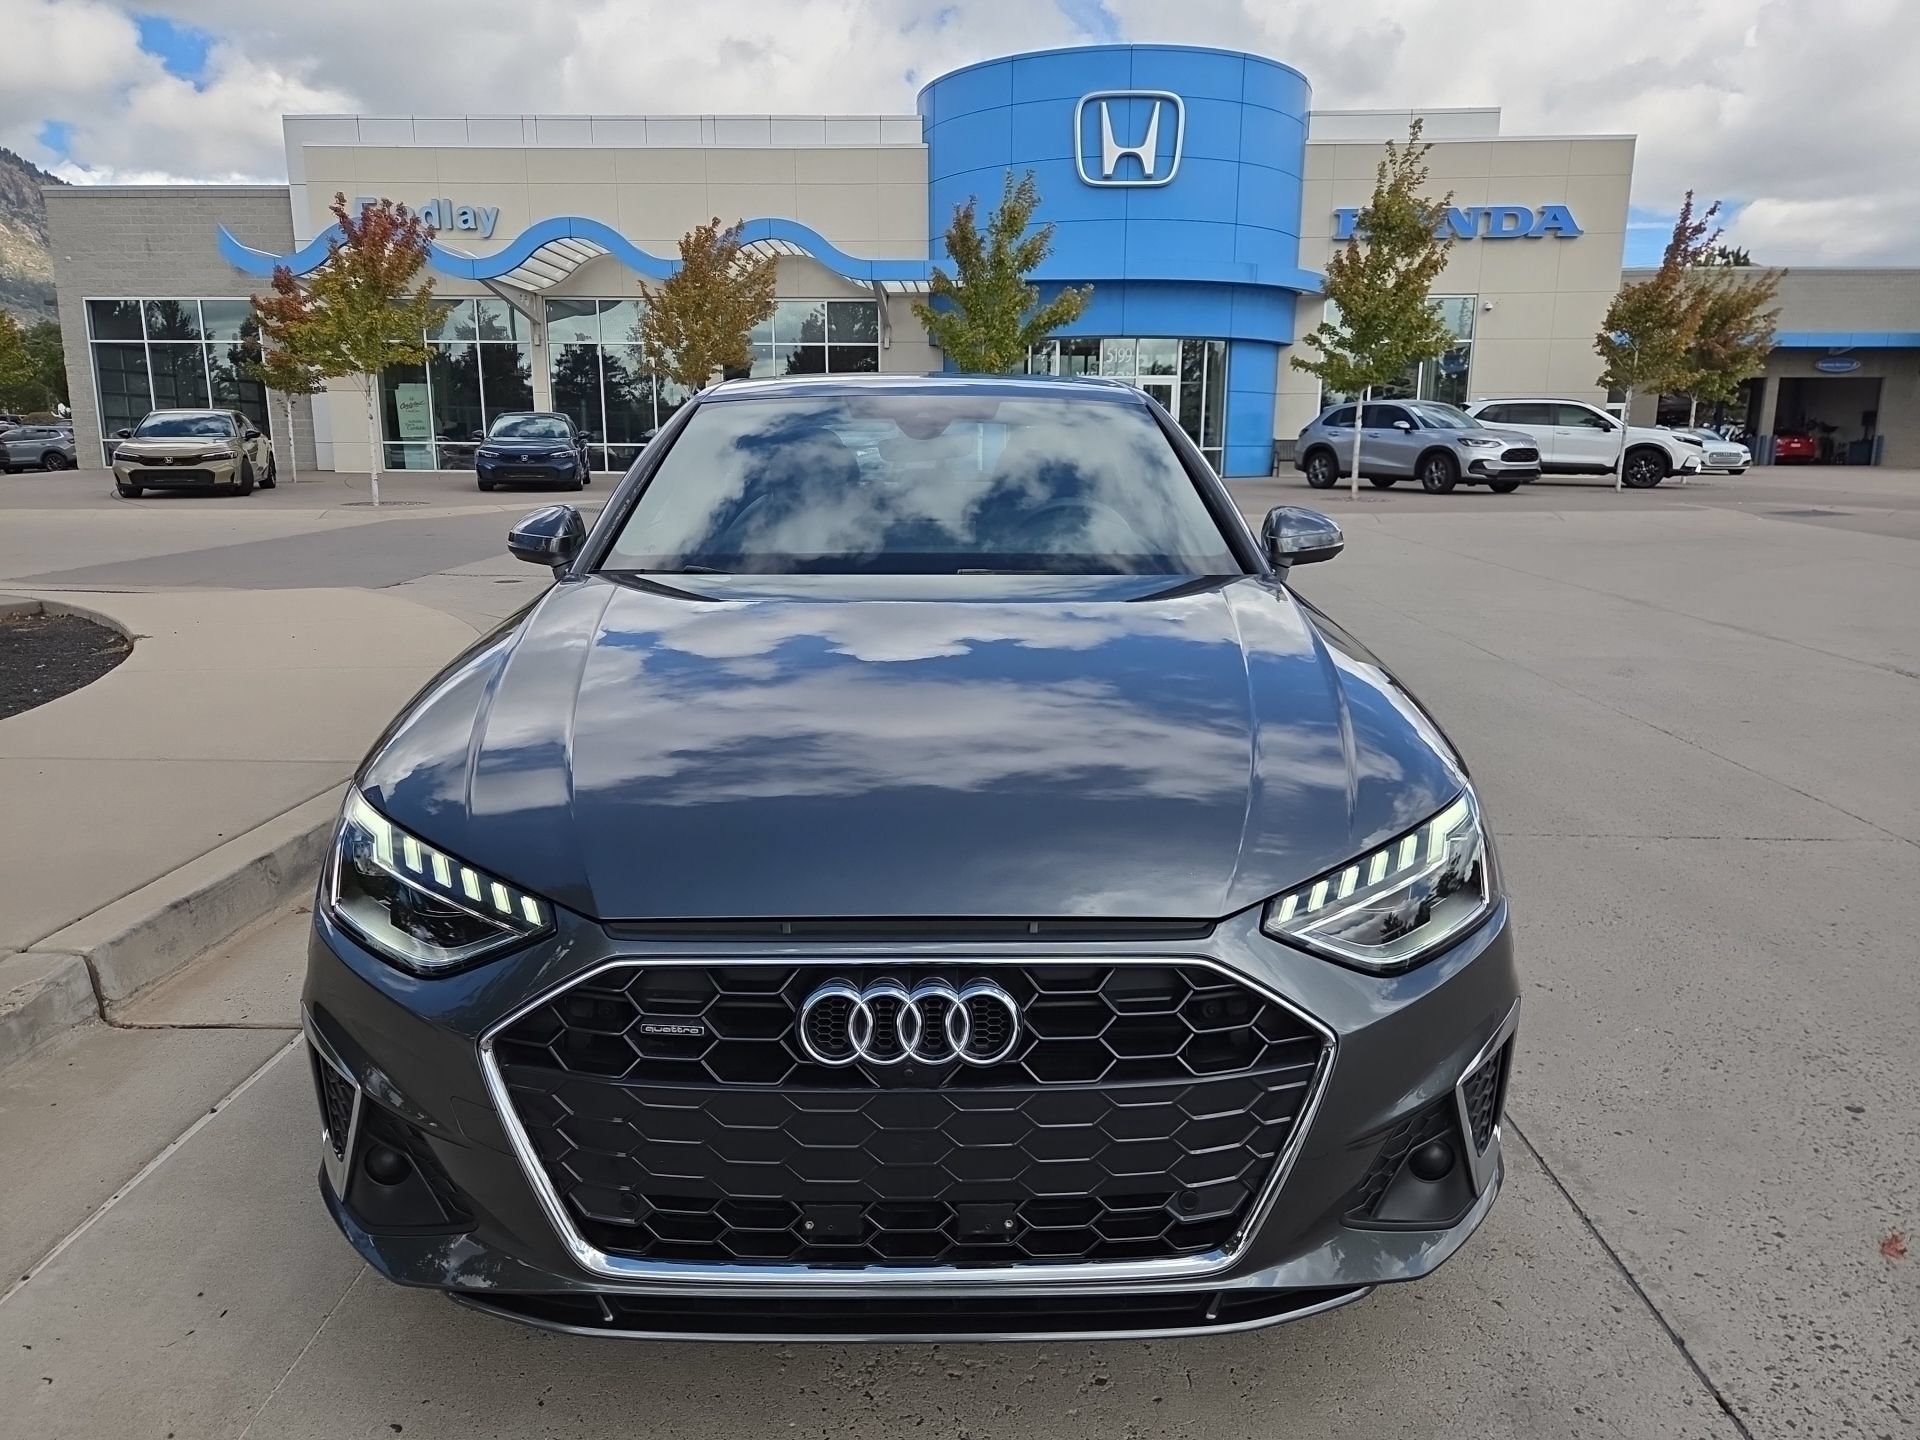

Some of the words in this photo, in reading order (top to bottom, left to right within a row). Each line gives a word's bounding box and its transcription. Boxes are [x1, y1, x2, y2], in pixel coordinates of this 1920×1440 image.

[353, 196, 500, 239] Fdlay
[1332, 205, 1584, 241] HNDA
[1106, 347, 1133, 363] 5199
[645, 1026, 699, 1034] quattro
